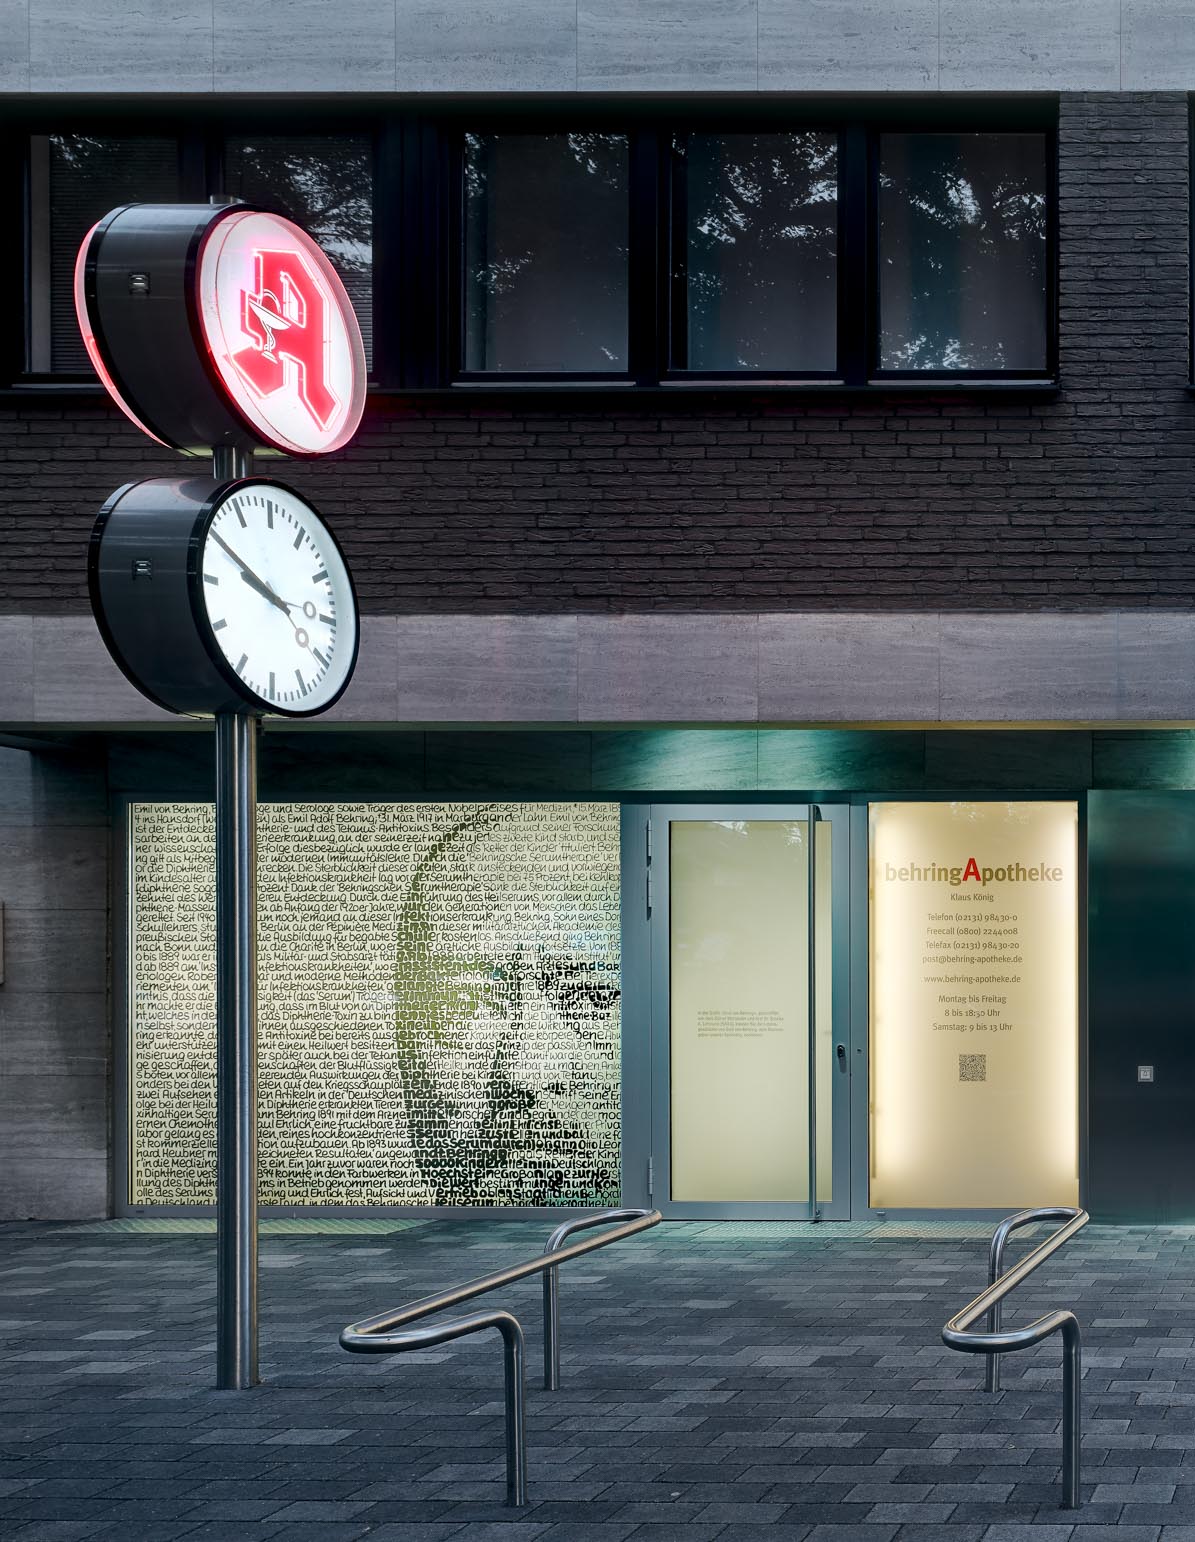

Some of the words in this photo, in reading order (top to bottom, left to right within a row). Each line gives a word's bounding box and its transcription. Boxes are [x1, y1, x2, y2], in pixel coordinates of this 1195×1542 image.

[135, 804, 152, 813] Emil
[294, 804, 334, 815] Serologe
[338, 804, 365, 813] sowie
[367, 804, 394, 815] Träger
[416, 804, 446, 813] ersten
[158, 814, 200, 825] Hansdorf
[288, 814, 308, 823] Emil
[311, 814, 334, 825] Adolf
[393, 814, 415, 823] März
[416, 814, 432, 823] 1917
[523, 814, 546, 823] Lahn
[493, 824, 539, 835] aufgrund
[542, 824, 570, 833] seiner
[374, 834, 427, 843] seinerzeit
[537, 834, 556, 843] Kind
[293, 843, 365, 855] diesbezüglich
[367, 843, 400, 852] wurde
[271, 853, 324, 862] modernen
[328, 853, 410, 862] Immunitätslehre
[378, 863, 408, 872] dieser
[451, 863, 474, 872] stark
[477, 863, 546, 872] ansteckenden
[885, 857, 1064, 887] behringApotheke
[150, 873, 206, 882] Kindesalter
[279, 873, 376, 884] Infektionskrankheit
[291, 883, 317, 892] Dank
[557, 893, 581, 902] allem
[584, 893, 610, 902] durch
[950, 893, 971, 901] Klaus
[973, 893, 994, 903] König
[285, 902, 320, 914] Anfang
[340, 902, 368, 911] 1920er
[446, 902, 511, 911] Generationen
[533, 902, 576, 911] Menschen
[177, 912, 195, 921] Seit
[198, 912, 215, 921] 1940
[276, 912, 299, 921] noch
[301, 912, 340, 924] jemand
[359, 912, 390, 921] dieser
[578, 912, 604, 921] eines
[928, 913, 953, 921] Telefon
[955, 913, 983, 922] (02131)
[261, 922, 290, 931] Berlin
[553, 922, 603, 931] Akademie
[926, 927, 955, 935] Freecall
[956, 927, 981, 936] (0800)
[983, 928, 1018, 936] 2244008
[136, 932, 198, 943] preußischen
[274, 932, 332, 943] Ausbildung
[350, 932, 390, 943] begabte
[495, 932, 560, 943] Anschließend
[136, 942, 162, 951] nach
[164, 942, 192, 951] Bonn
[926, 941, 951, 949] Telefax
[953, 941, 980, 950] (02131)
[159, 952, 180, 961] 1889
[331, 952, 377, 961] Stabsarzt
[922, 955, 1023, 964] post@behring-apotheke.de
[159, 962, 179, 971] 1889
[294, 971, 342, 980] moderne
[344, 971, 396, 980] Methoden
[924, 975, 1021, 984] www.behring-apotheke.de
[172, 991, 196, 1000] dass
[938, 995, 967, 1004] Montag
[968, 995, 980, 1003] bis
[981, 995, 1007, 1004] Freitag
[279, 1001, 304, 1010] dass
[320, 1001, 341, 1010] Blut
[149, 1011, 190, 1020] welches
[283, 1011, 357, 1022] Diphtherie-Toxin
[944, 1009, 950, 1017] 8
[952, 1009, 963, 1017] bis
[987, 1009, 1001, 1017] Uhr
[290, 1021, 384, 1032] ausgeschiedenen
[932, 1023, 967, 1032] Samstag:
[976, 1023, 988, 1031] bis
[990, 1024, 998, 1033] 13
[999, 1023, 1013, 1031] Uhr
[266, 1030, 316, 1039] Antitoxine
[336, 1030, 370, 1039] bereits
[278, 1040, 305, 1049] einen
[309, 1040, 348, 1049] Heilwert
[548, 1040, 591, 1052] passiven
[269, 1050, 301, 1061] später
[304, 1050, 332, 1059] auch
[310, 1070, 380, 1081] Auswirkungen
[434, 1080, 459, 1089] Ende
[461, 1080, 481, 1089] 1890
[570, 1080, 610, 1091] Behring
[136, 1090, 160, 1099] zwei
[163, 1090, 211, 1101] Aufsehen
[275, 1090, 315, 1099] Artikeln
[348, 1090, 402, 1099] Deutschen
[267, 1099, 316, 1111] Diphtherie
[319, 1099, 374, 1108] erkrankten
[375, 1099, 402, 1108] Tieren
[275, 1109, 315, 1120] Behring
[318, 1109, 334, 1118] 1891
[315, 1119, 336, 1128] eine
[337, 1119, 393, 1130] fruchtbare
[279, 1129, 310, 1138] reines
[367, 1139, 386, 1148] 1893
[578, 1139, 597, 1148] Otto
[163, 1149, 206, 1158] Heubner
[306, 1158, 325, 1167] Jahr
[391, 1158, 414, 1167] noch
[145, 1168, 195, 1180] Diphtherie
[276, 1168, 311, 1177] konnte
[347, 1168, 408, 1177] Farbwerken
[288, 1178, 324, 1187] Betrieb
[326, 1180, 386, 1189] genommen
[176, 1188, 213, 1197] Serums
[311, 1188, 344, 1197] Ehrlich
[366, 1188, 405, 1199] Aufsicht
